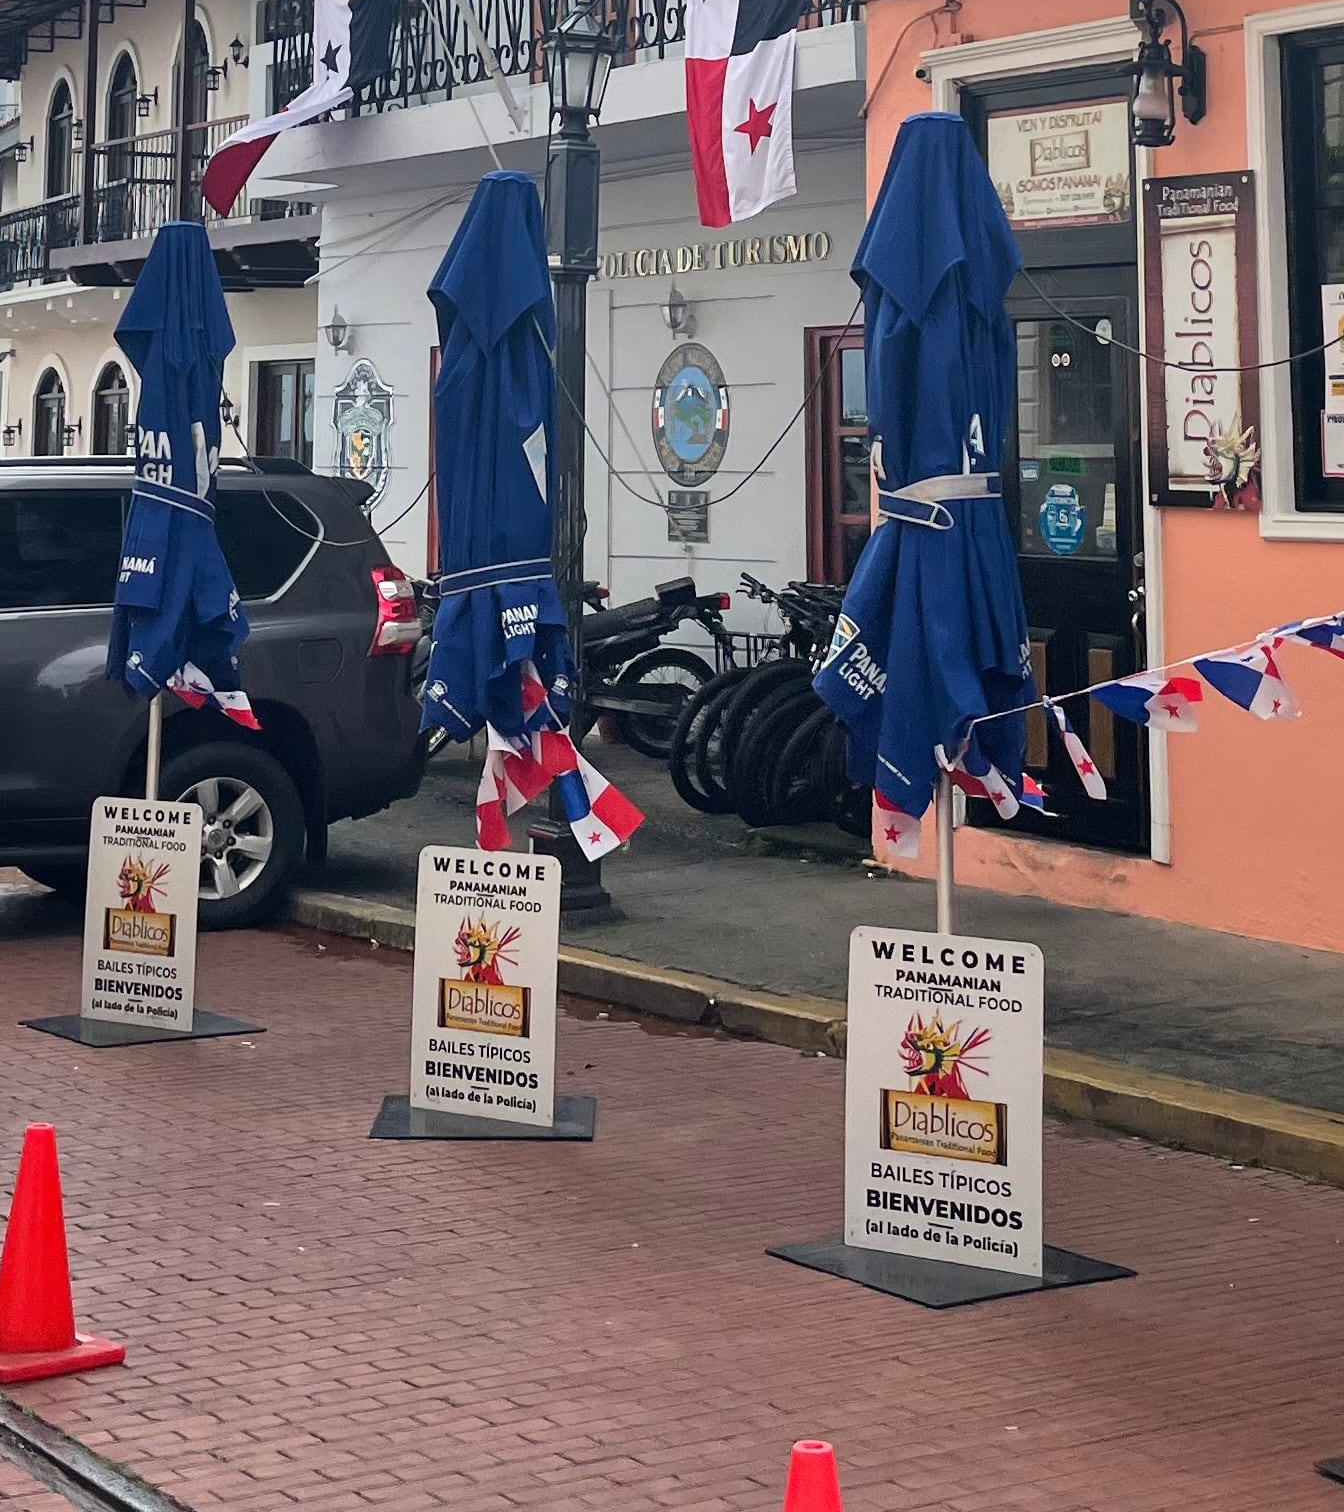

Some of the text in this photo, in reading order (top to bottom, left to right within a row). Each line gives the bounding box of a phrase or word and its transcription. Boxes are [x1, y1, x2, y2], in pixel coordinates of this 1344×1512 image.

[1162, 184, 1233, 202] Panamanian
[1213, 197, 1239, 212] Food
[677, 244, 705, 273] DE
[712, 231, 833, 269] TURISMO
[1175, 239, 1217, 442] Diablicos
[504, 622, 536, 639] LIGHT
[839, 662, 875, 700] LIGHT
[104, 806, 191, 825] WELCOME
[116, 825, 175, 838] PANAMANIAN
[103, 836, 186, 852] TRADITIONAL FOOD
[434, 857, 545, 881] WELCOME
[450, 880, 527, 897] PANAMANIAN
[434, 893, 541, 913] TRADITIONAL FOOD
[112, 916, 168, 943] Diablicos
[872, 941, 1025, 974] WELCOME
[98, 960, 177, 979] BAILES TÍPICOS
[896, 969, 1001, 992] PANAMANIAN
[95, 978, 183, 1000] BIENVENIDOS
[875, 984, 1023, 1013] TRADITIONAL FOOD
[104, 1000, 122, 1011] lado
[124, 1003, 134, 1012] de
[137, 1004, 144, 1013] la
[449, 987, 521, 1020] Diablicos
[429, 1039, 531, 1064] BAILES TÍPICOS
[426, 1061, 538, 1089] BIENVENIDOS
[426, 1085, 439, 1098] (al
[442, 1087, 464, 1100] lado
[468, 1091, 481, 1103] de
[484, 1092, 493, 1104] la
[894, 1101, 994, 1142] Diablicos
[936, 1140, 975, 1154] Traditional
[871, 1162, 1012, 1197] BAILES TÍPICOS
[867, 1189, 1023, 1230] BIENVENIDOS
[866, 1219, 1018, 1257] (al lado de la Policía)
